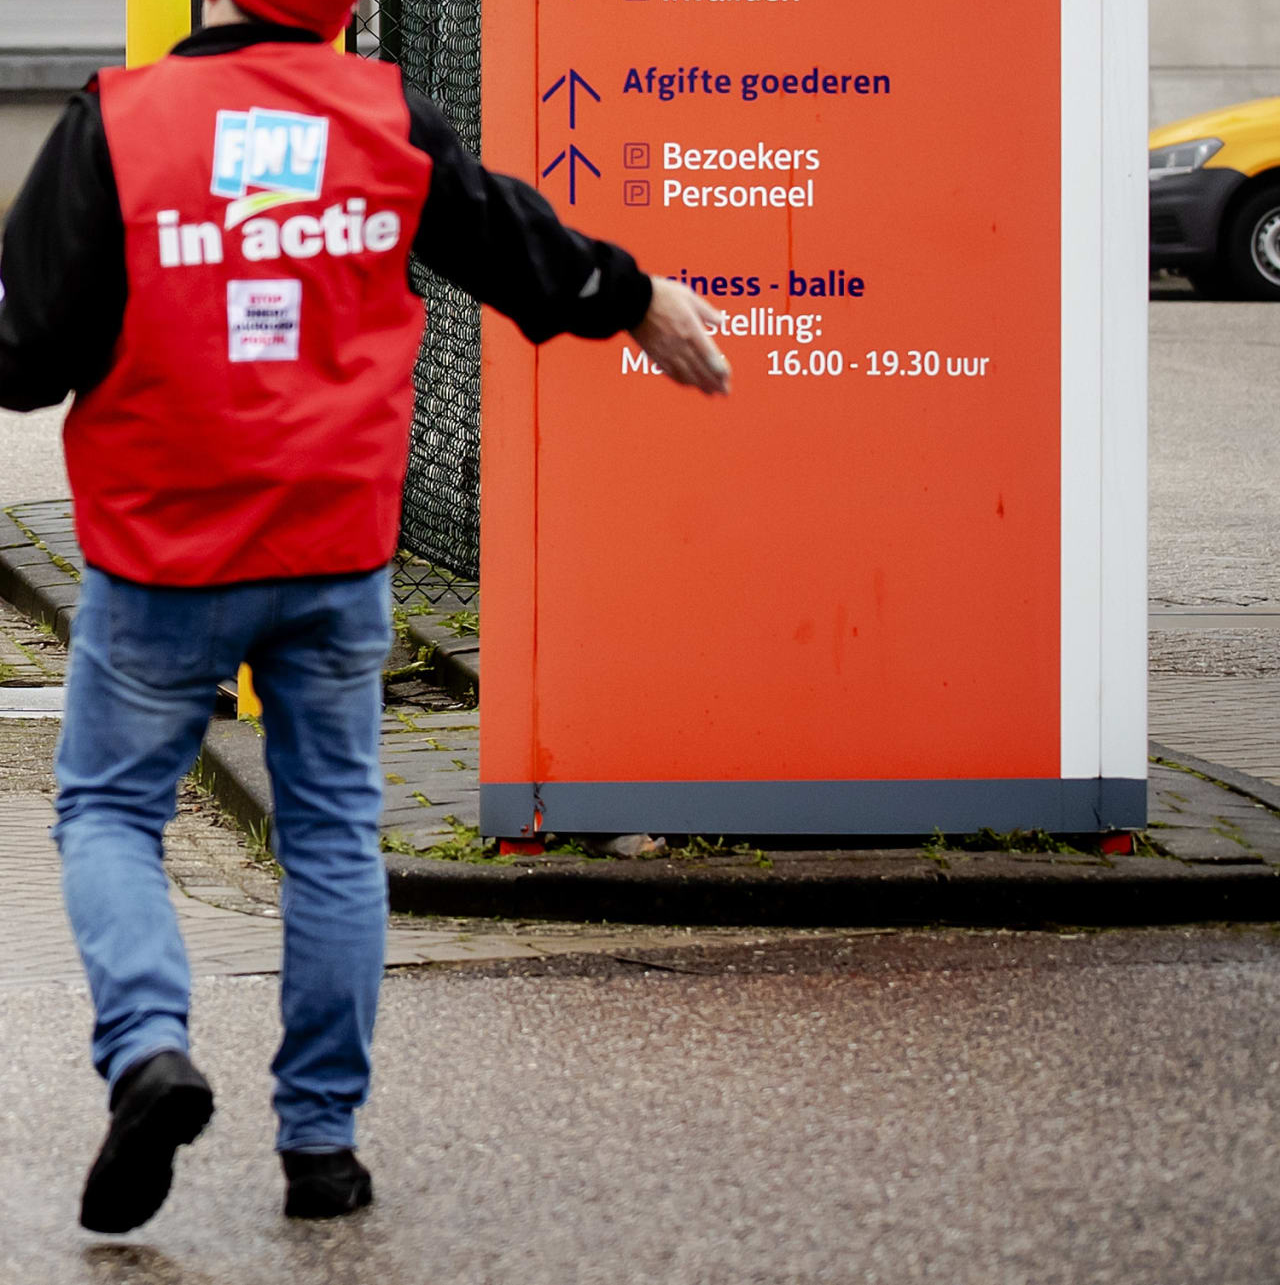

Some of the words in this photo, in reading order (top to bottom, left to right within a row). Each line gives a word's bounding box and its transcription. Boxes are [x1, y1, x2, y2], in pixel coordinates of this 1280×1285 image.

[623, 66, 732, 101] Afgifte
[741, 66, 891, 101] goederen
[219, 125, 320, 179] FNV
[663, 141, 820, 171] Bezoekers
[663, 178, 815, 208] Personeel
[156, 209, 224, 268] in
[241, 196, 401, 262] actie
[666, 269, 762, 298] iness
[788, 269, 865, 298] balie
[767, 350, 844, 377] 16.00
[866, 350, 940, 377] 19.30
[946, 357, 991, 378] uur
